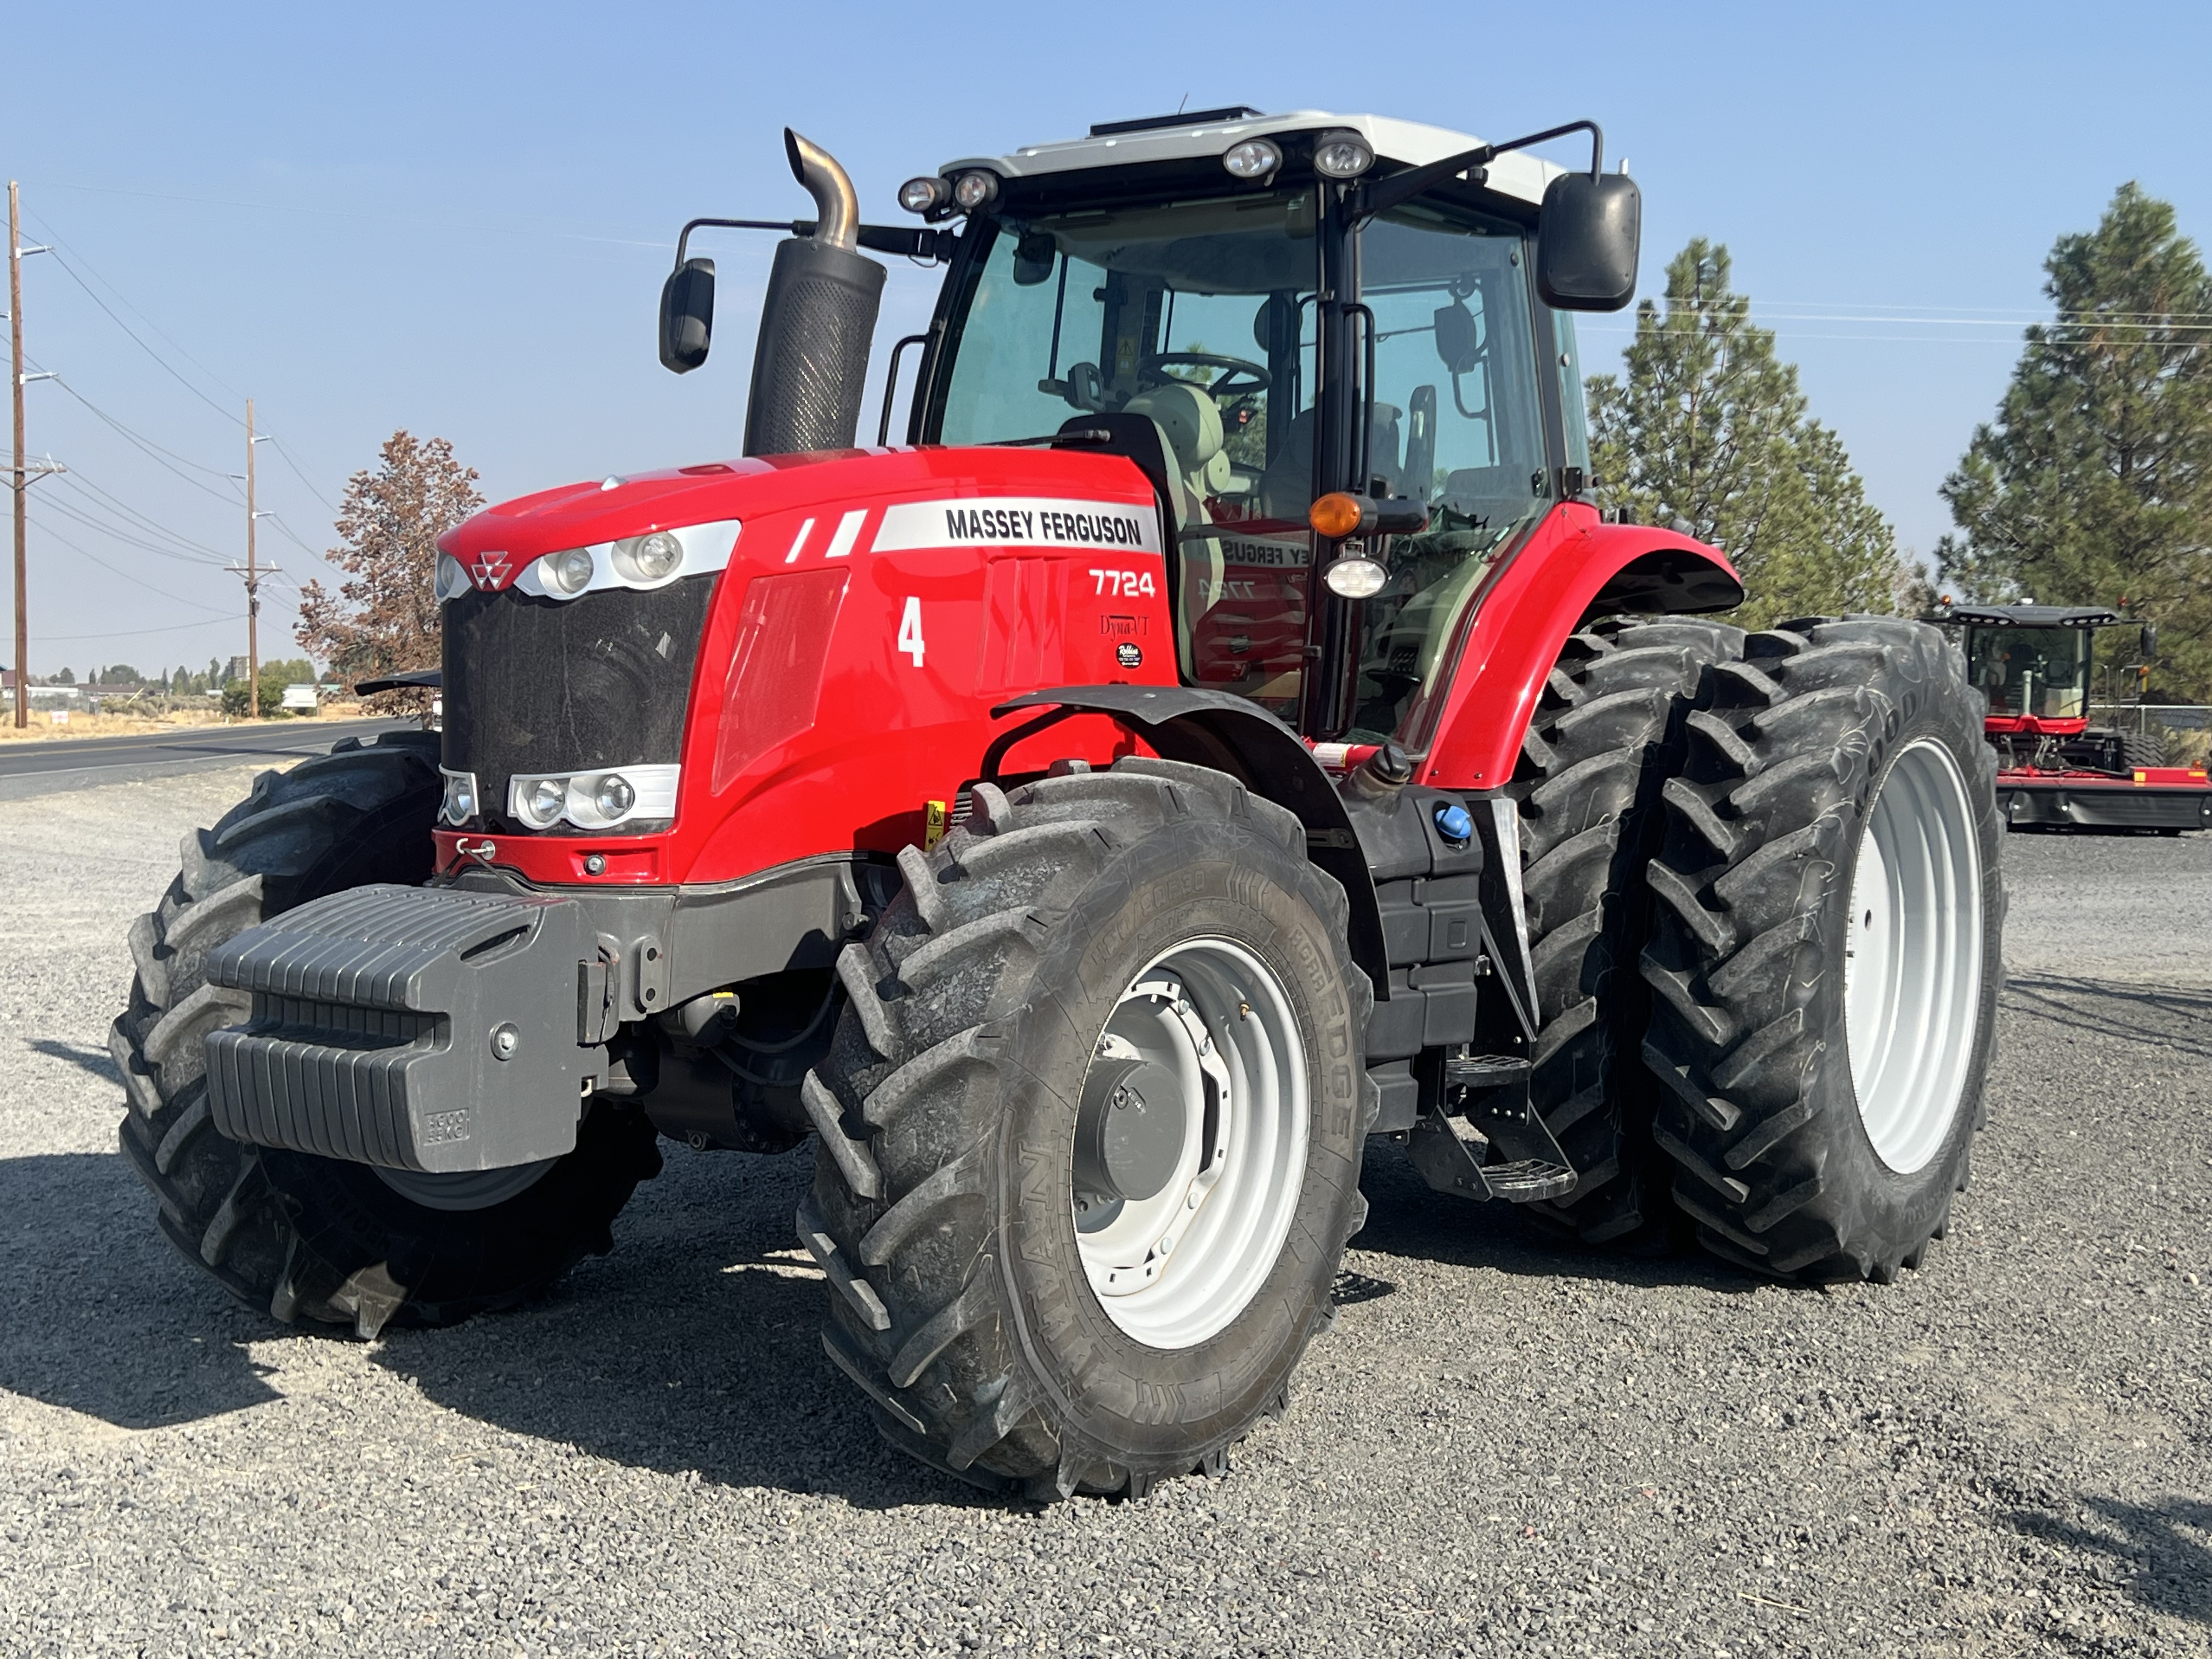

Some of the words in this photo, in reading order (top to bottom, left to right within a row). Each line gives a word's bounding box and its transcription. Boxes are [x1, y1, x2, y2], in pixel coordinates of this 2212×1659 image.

[945, 510, 1032, 539] MASSEY
[1040, 511, 1142, 546] FERGUSON
[1088, 569, 1156, 603] 7724
[898, 596, 925, 668] 4
[1100, 615, 1149, 642] Dyna-VT
